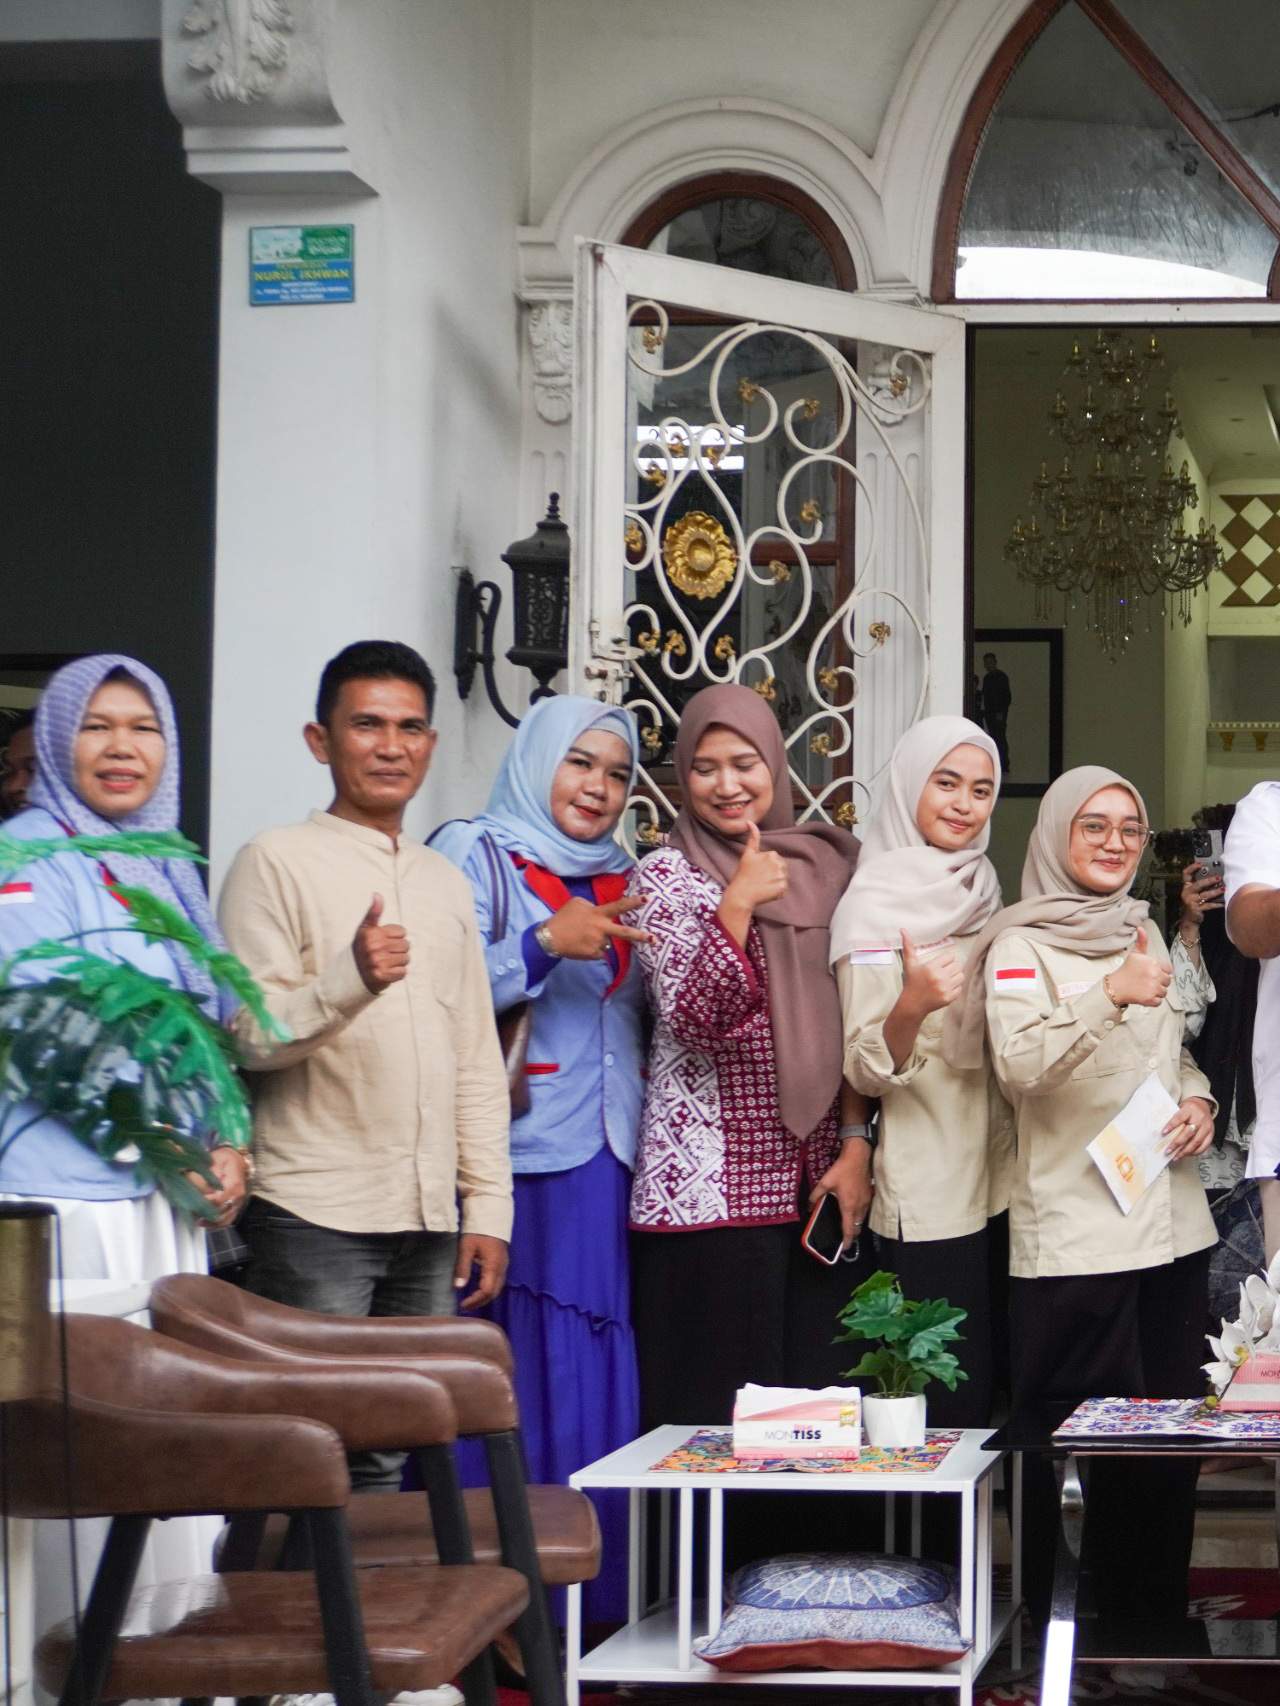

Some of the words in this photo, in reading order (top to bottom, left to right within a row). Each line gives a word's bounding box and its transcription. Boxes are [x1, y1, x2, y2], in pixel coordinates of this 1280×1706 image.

[255, 270, 295, 282] NURUL
[301, 269, 349, 281] IKHWAN
[764, 1430, 822, 1440] MONTISS
